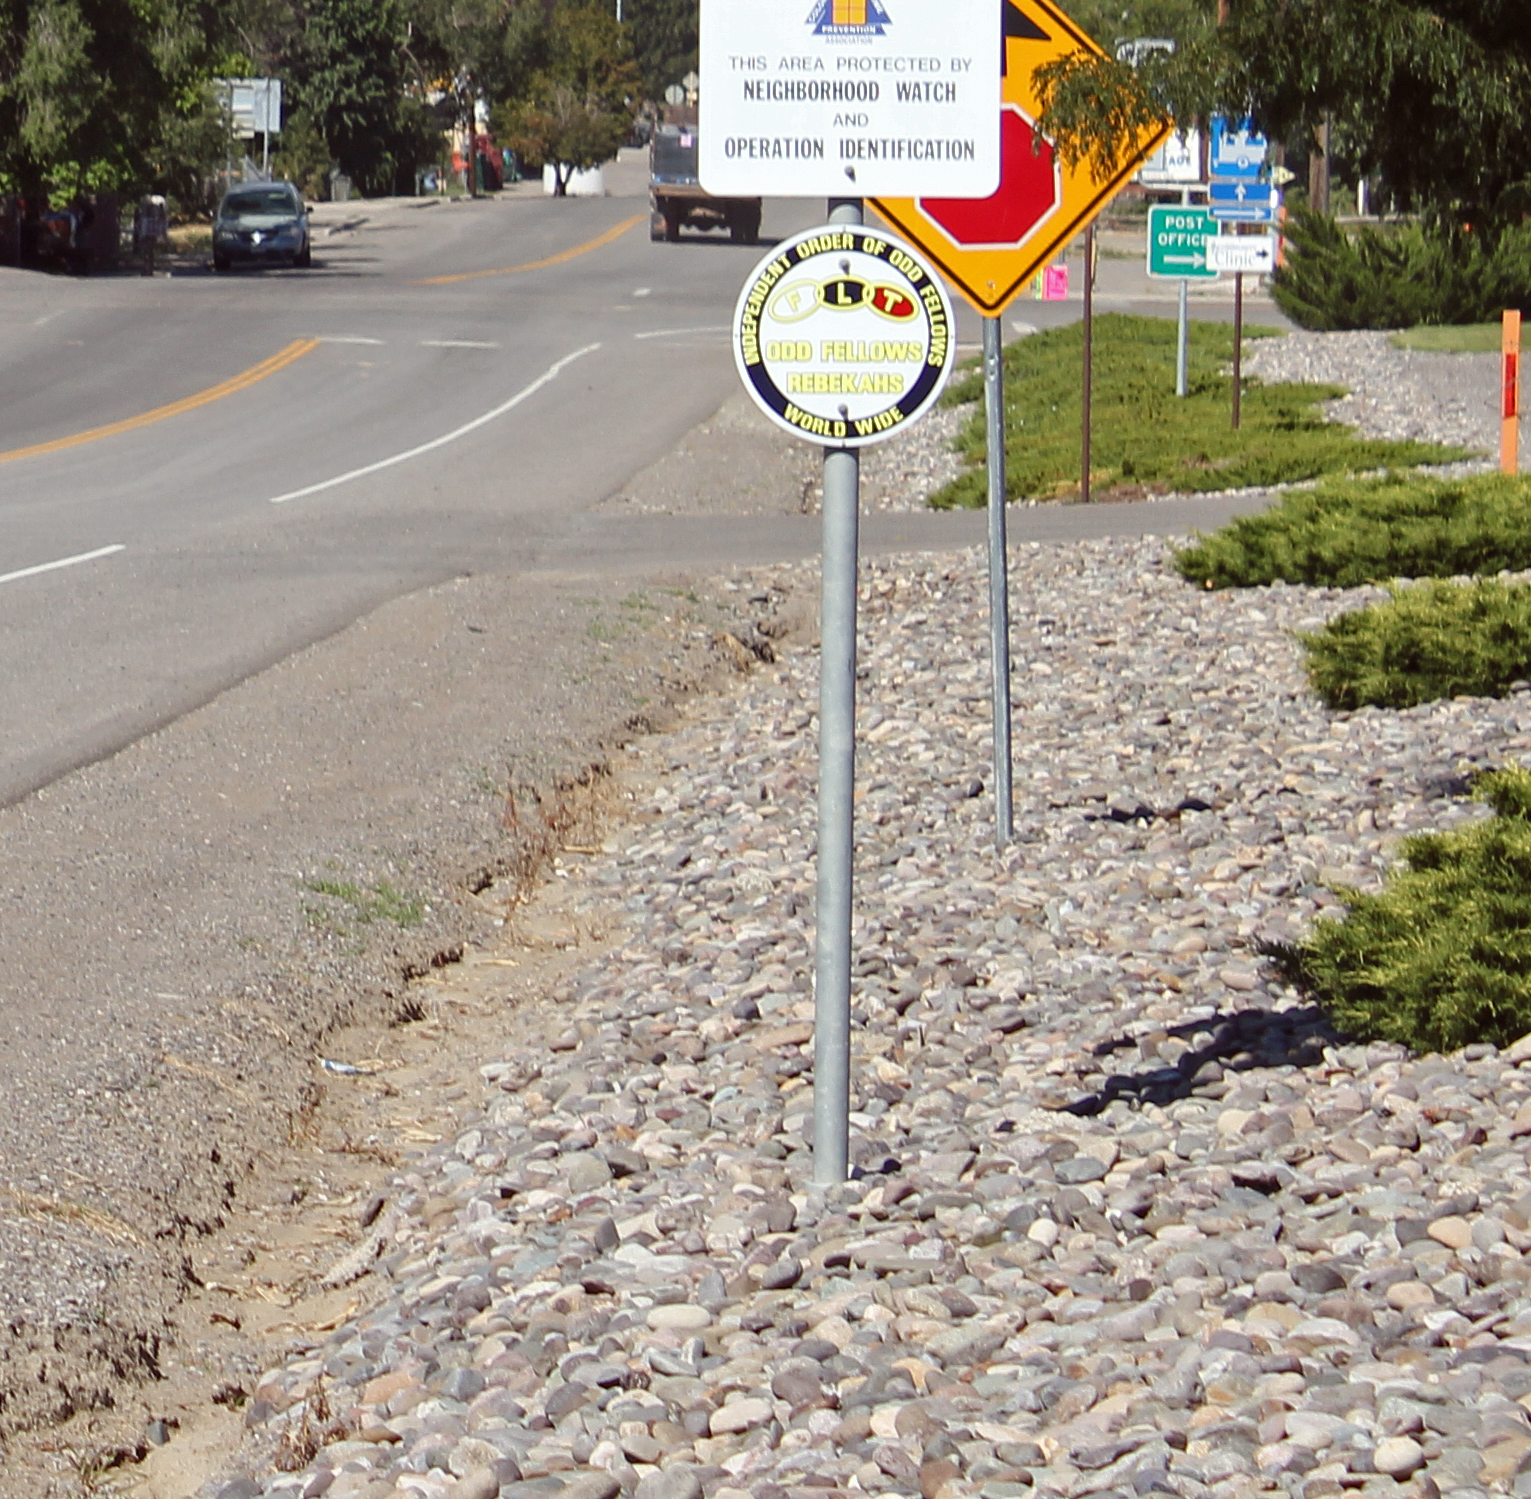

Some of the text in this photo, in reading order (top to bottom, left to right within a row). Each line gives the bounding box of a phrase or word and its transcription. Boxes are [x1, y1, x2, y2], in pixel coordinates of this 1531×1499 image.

[729, 56, 972, 74] THIS AREA PROTECTED BY
[743, 79, 956, 102] NEIGHBORHOOD WATCH
[833, 113, 869, 128] AND
[724, 137, 975, 160] OPERATION IDENTIFICATION
[1165, 215, 1204, 230] POST
[741, 232, 947, 368] INDEPENDENT ORDER OF ODD FELLOWS
[785, 282, 903, 313] F L T
[767, 341, 923, 362] ODD FELLOWS
[787, 372, 904, 394] REBEKAHS
[784, 403, 904, 438] WORLD WIDE
